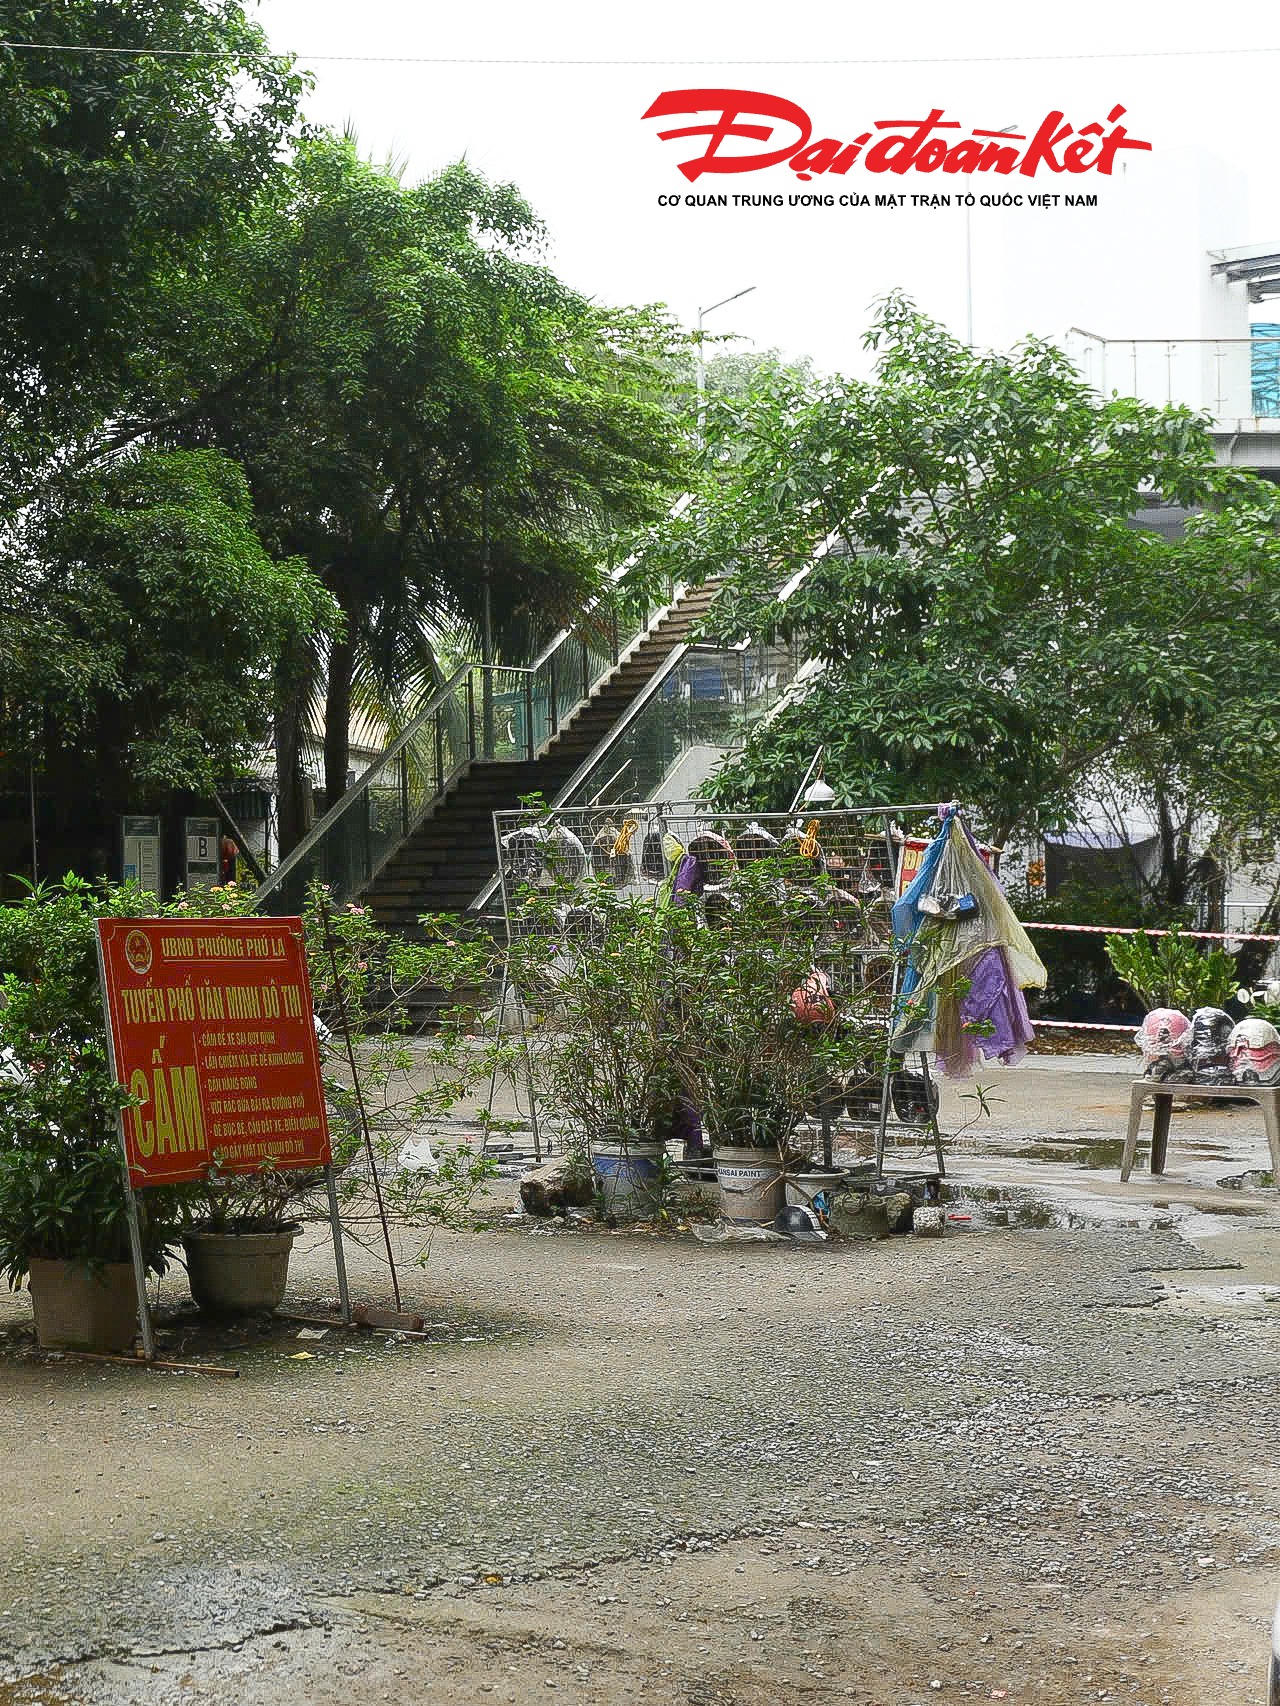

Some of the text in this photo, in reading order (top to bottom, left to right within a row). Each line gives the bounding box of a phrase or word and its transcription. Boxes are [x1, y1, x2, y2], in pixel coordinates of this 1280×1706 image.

[198, 837, 208, 858] B
[161, 937, 195, 957] UBND
[245, 934, 269, 957] PHÚ
[271, 937, 286, 957] LA
[121, 974, 304, 1024] TUYẾN PHỐ VĂN MINH ĐÔ THỊ
[130, 1034, 206, 1158] CẤM
[738, 1170, 761, 1178] PAINT
